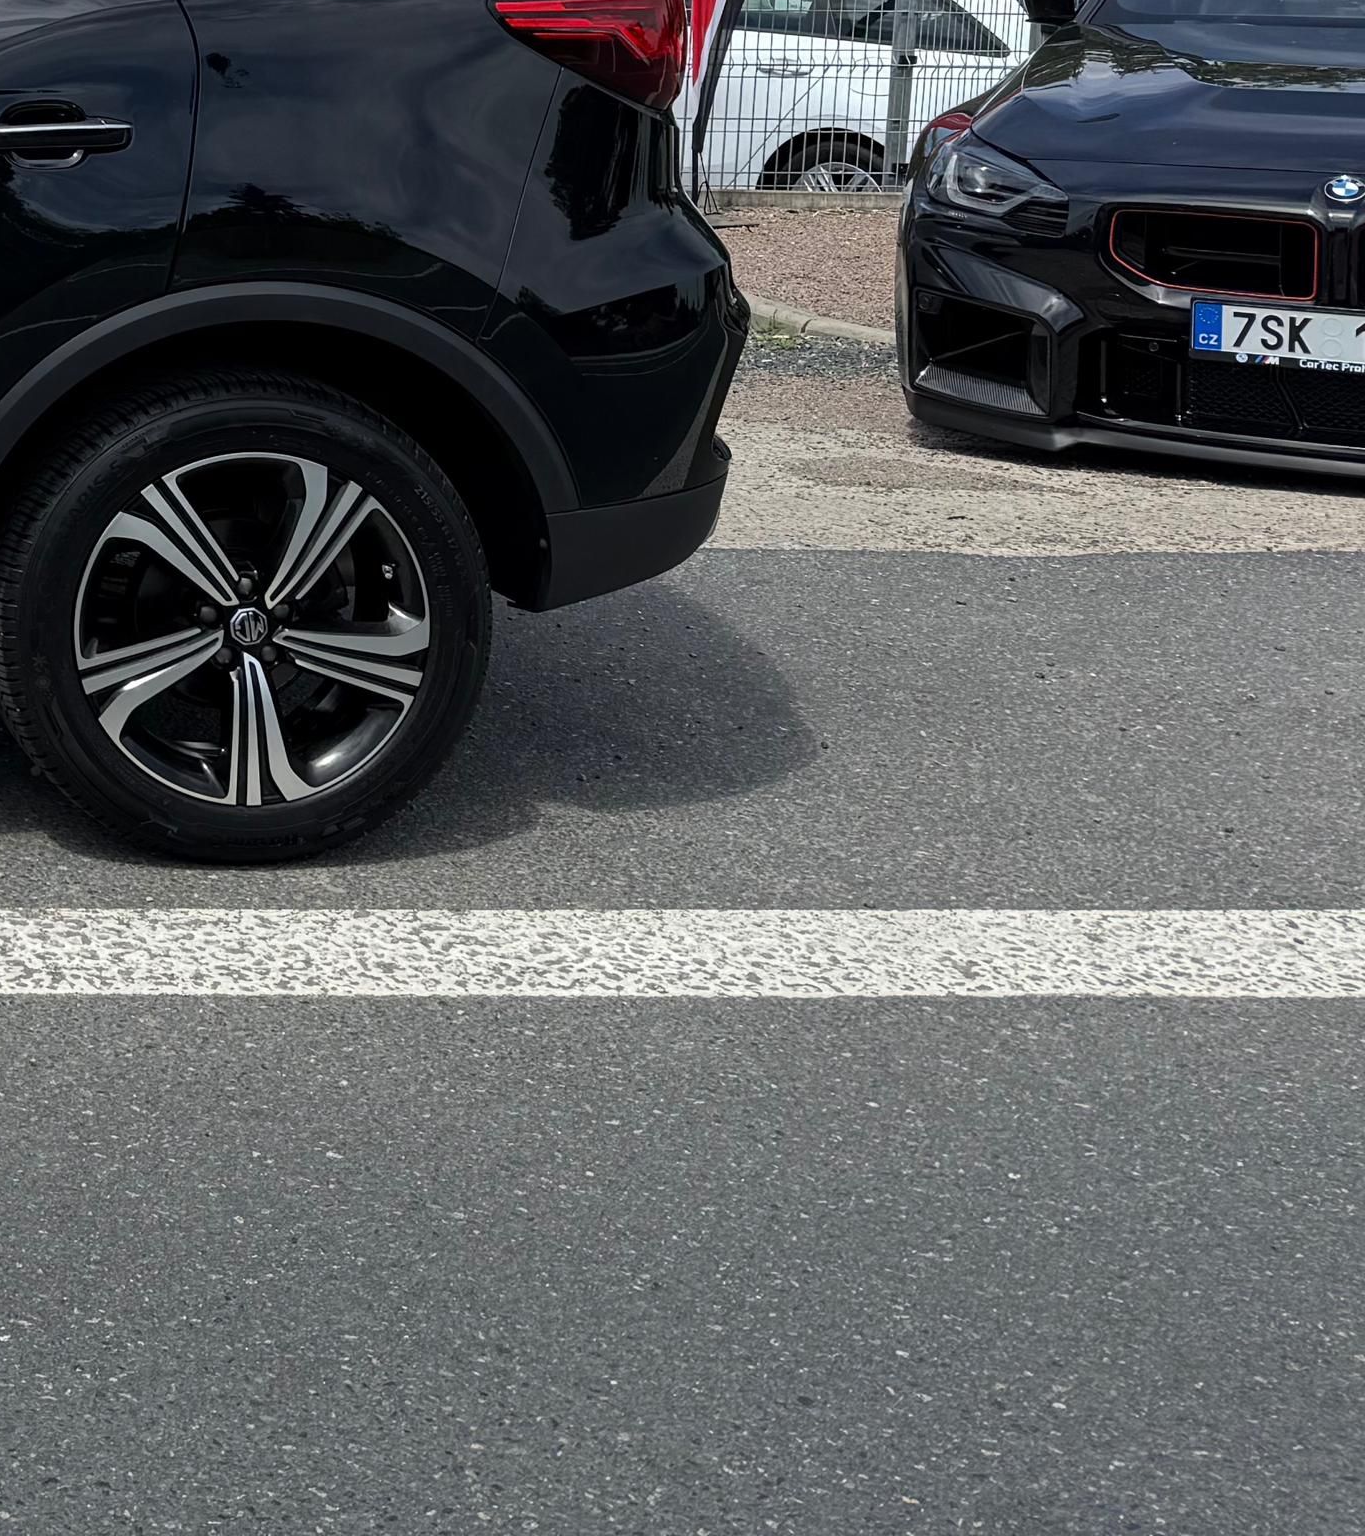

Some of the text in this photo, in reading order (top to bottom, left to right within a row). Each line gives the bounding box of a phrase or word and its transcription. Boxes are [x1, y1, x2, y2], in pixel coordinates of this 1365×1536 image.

[1232, 311, 1313, 354] 7SK
[1198, 333, 1219, 345] CZ
[1299, 359, 1339, 371] CarTec
